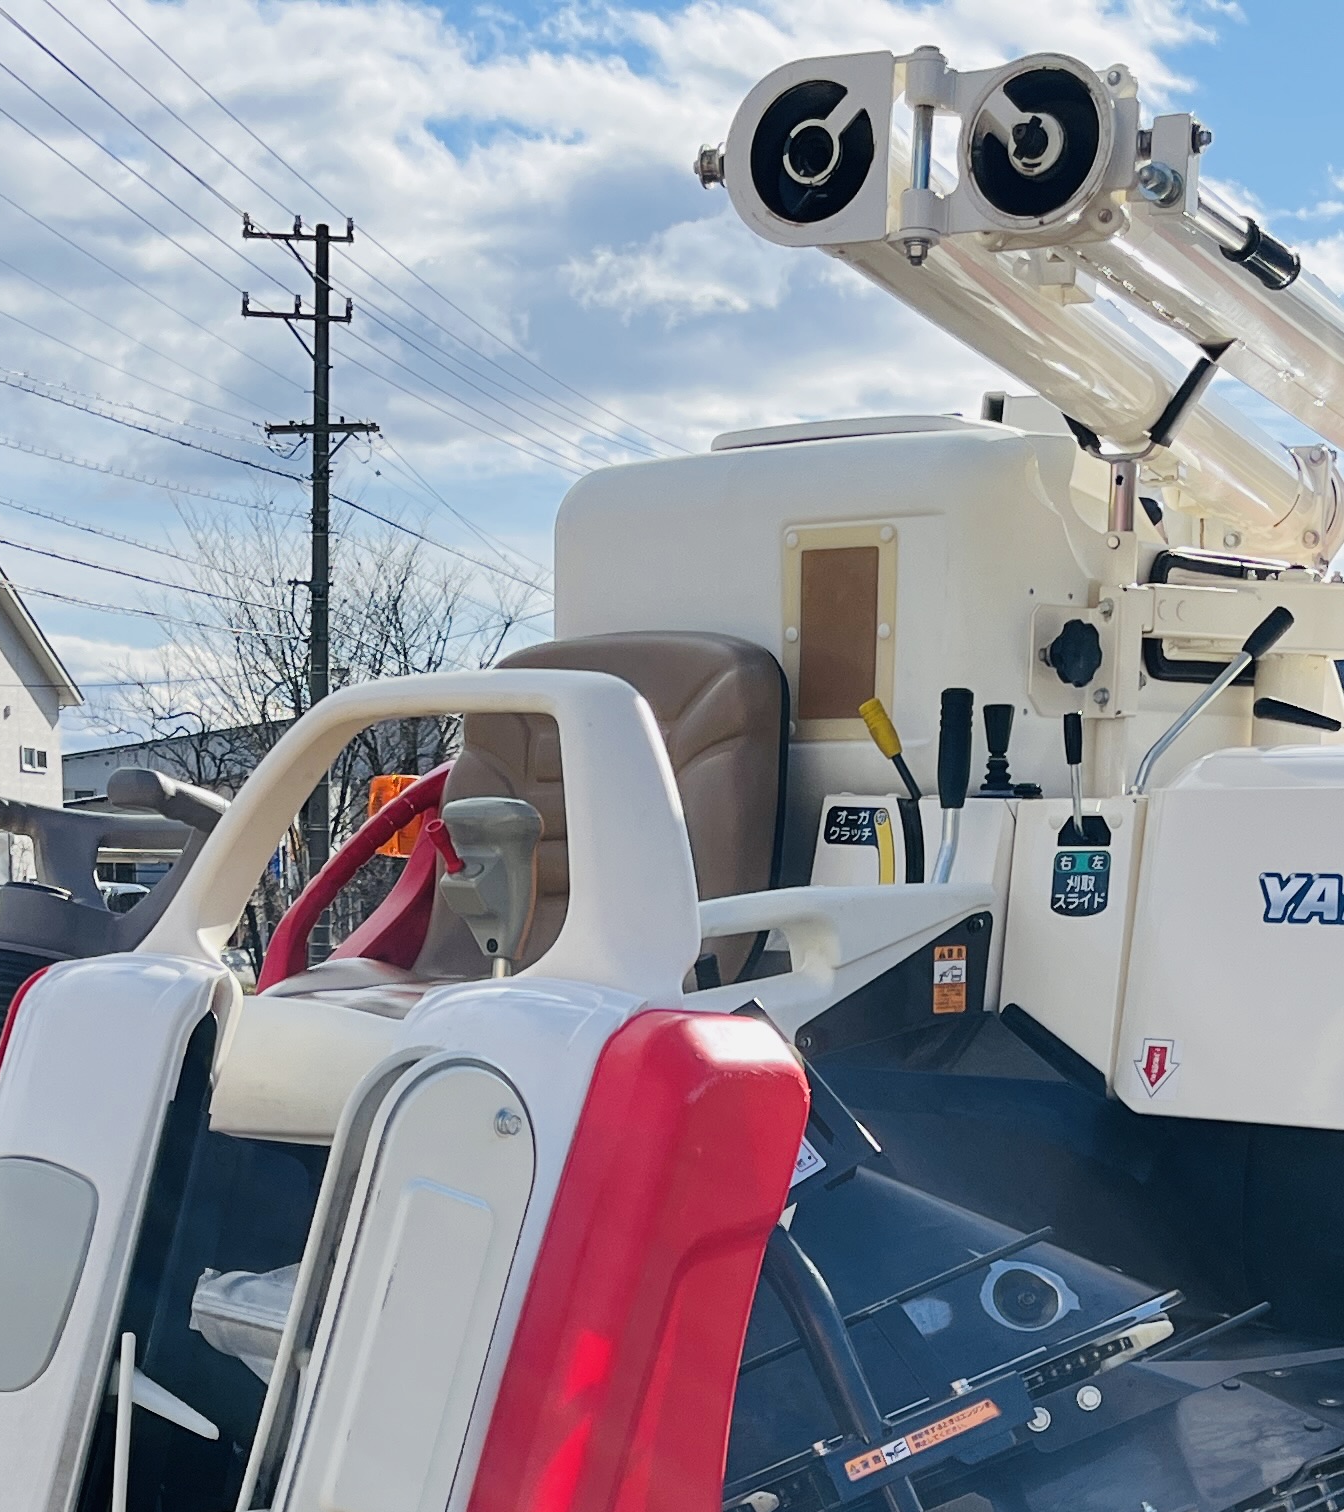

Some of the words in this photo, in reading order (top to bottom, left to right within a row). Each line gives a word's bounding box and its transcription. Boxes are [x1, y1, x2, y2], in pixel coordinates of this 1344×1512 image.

[836, 810, 870, 825] オーガ
[829, 826, 872, 842] クラッチ
[1059, 856, 1072, 870] 右
[1091, 855, 1104, 869] 左
[1065, 874, 1096, 892] 刈取
[1053, 893, 1105, 909] スライド
